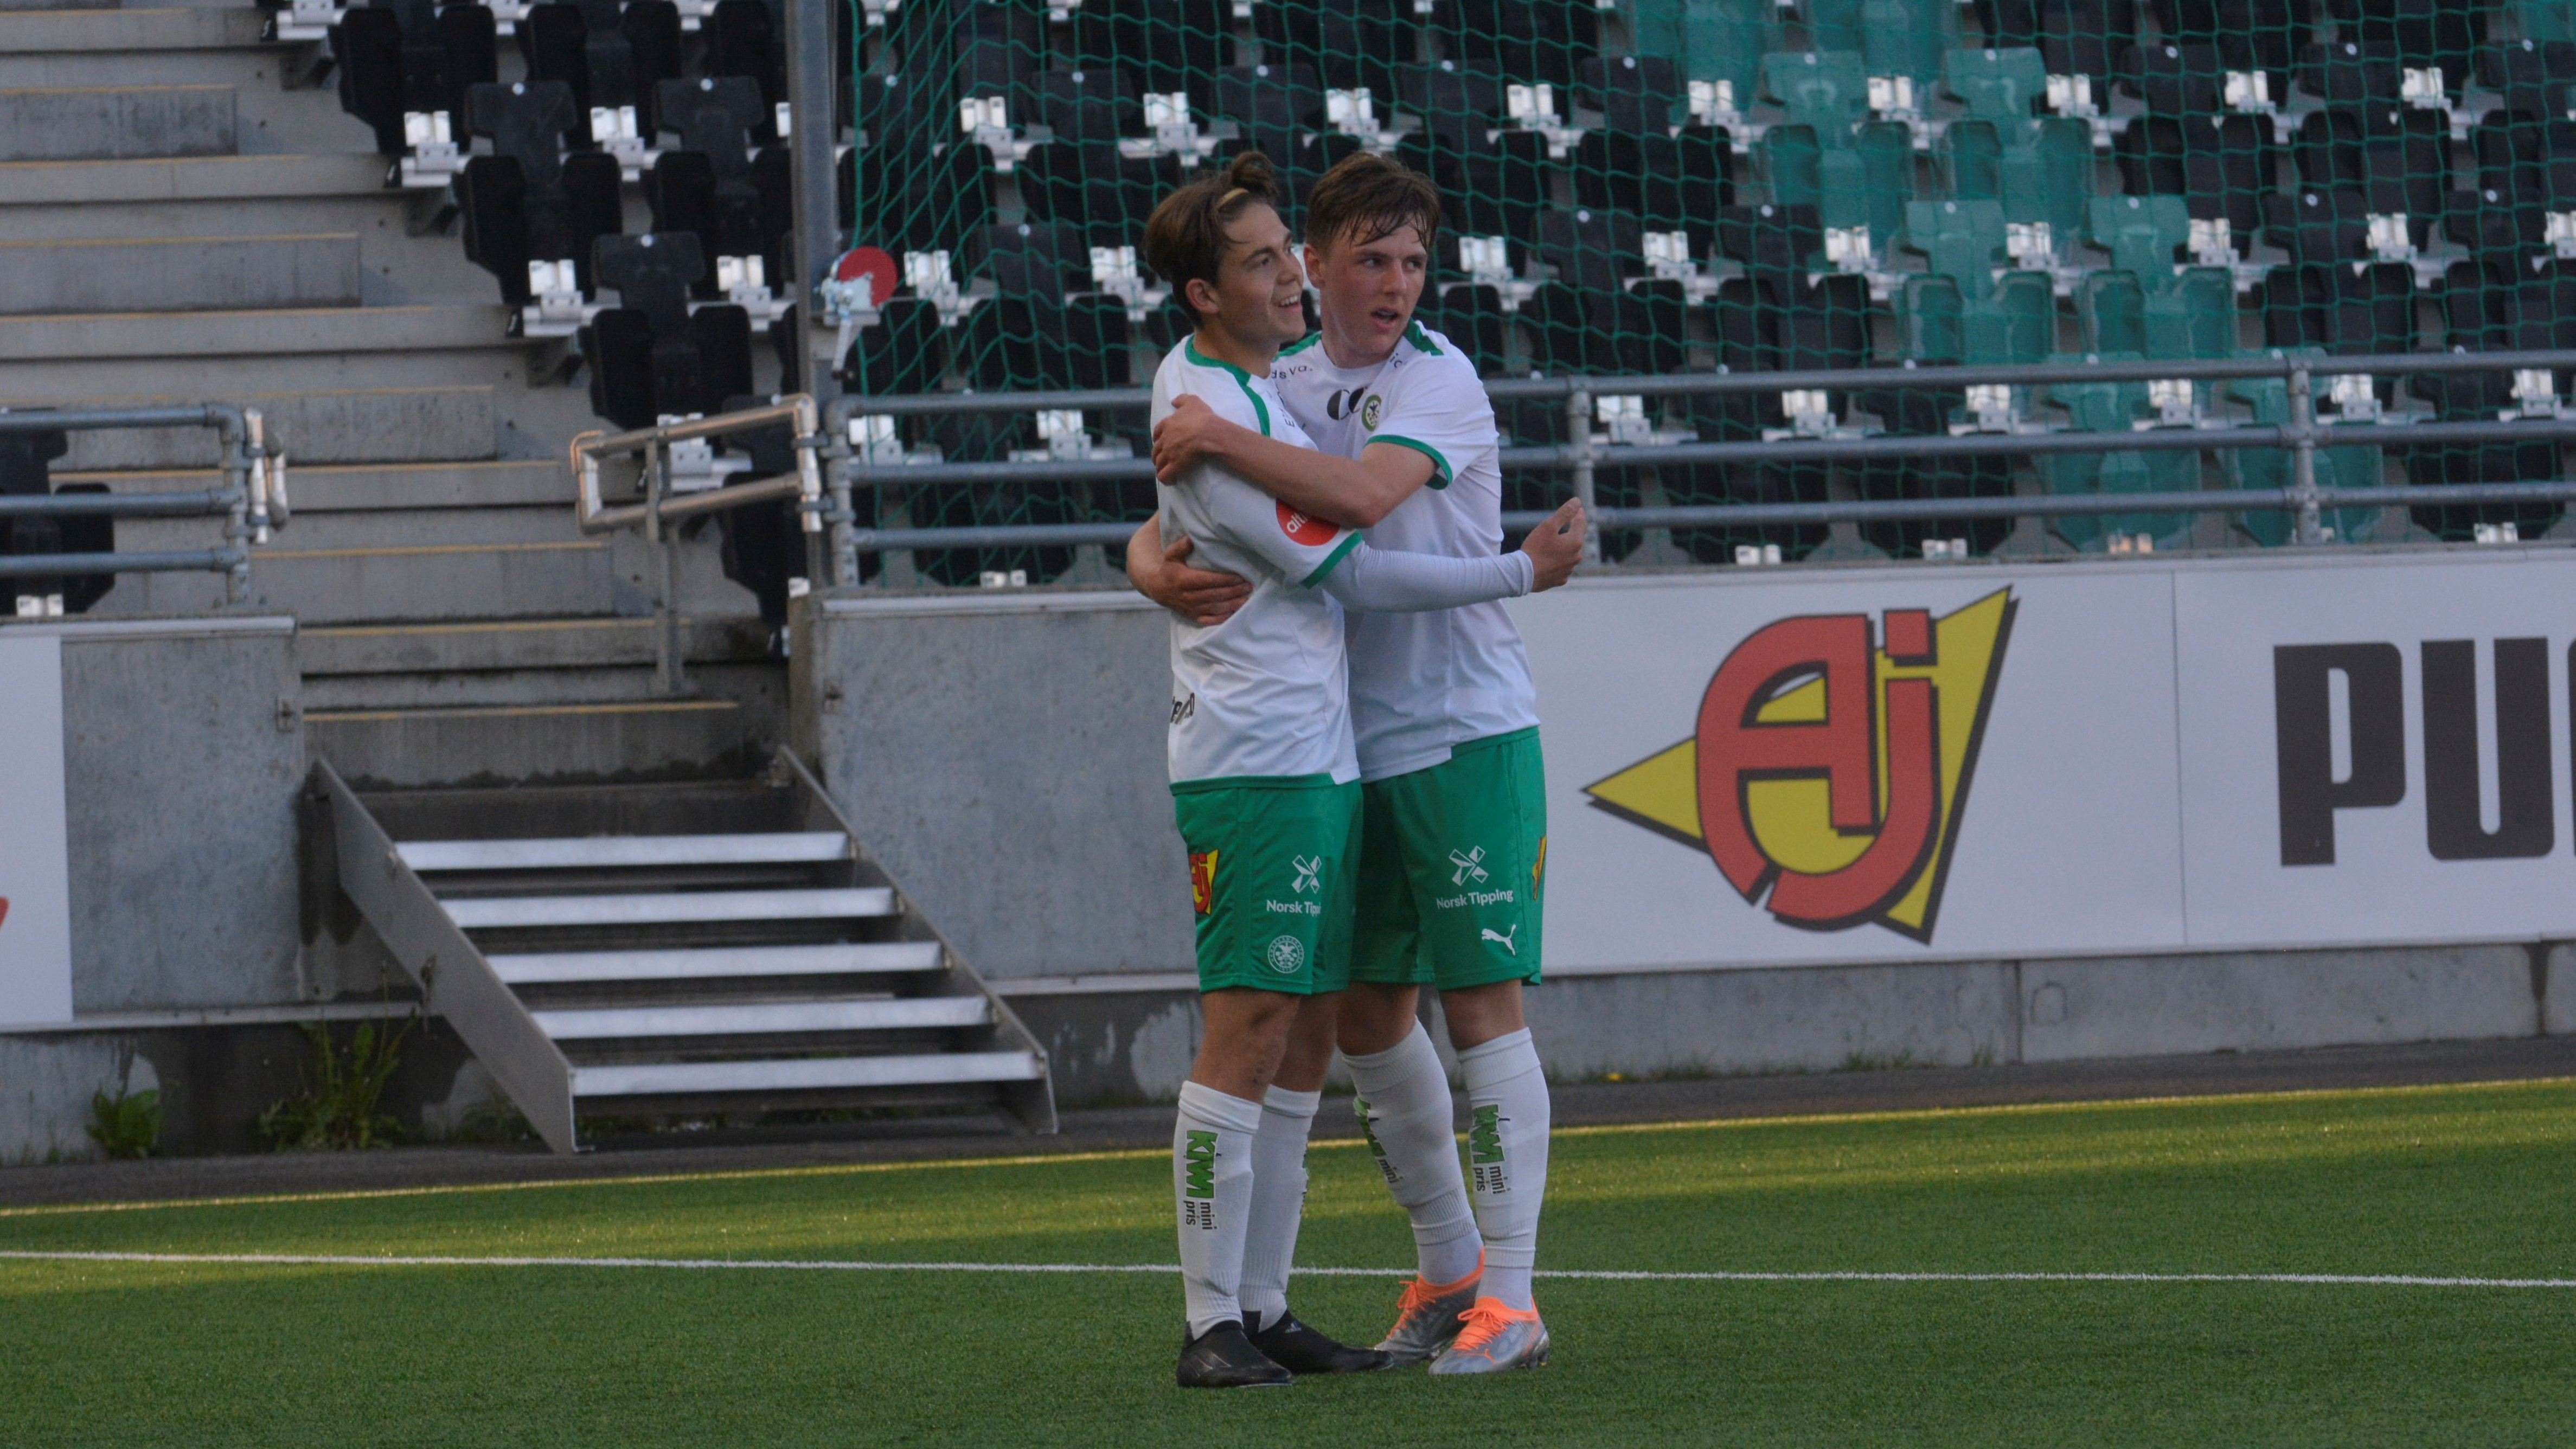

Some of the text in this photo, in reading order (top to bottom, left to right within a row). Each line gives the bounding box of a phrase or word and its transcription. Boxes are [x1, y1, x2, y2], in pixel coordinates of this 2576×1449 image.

[2274, 636, 2576, 867] PU
[1266, 899, 1303, 913] Norsk
[1437, 888, 1514, 909] Norsk Tipping
[1186, 1130, 1219, 1198] KIWI
[1377, 1159, 1404, 1184] mini
[1473, 1167, 1490, 1192] pris
[1489, 1166, 1511, 1194] mini
[1183, 1200, 1200, 1226] pris
[1200, 1202, 1217, 1230] mini
